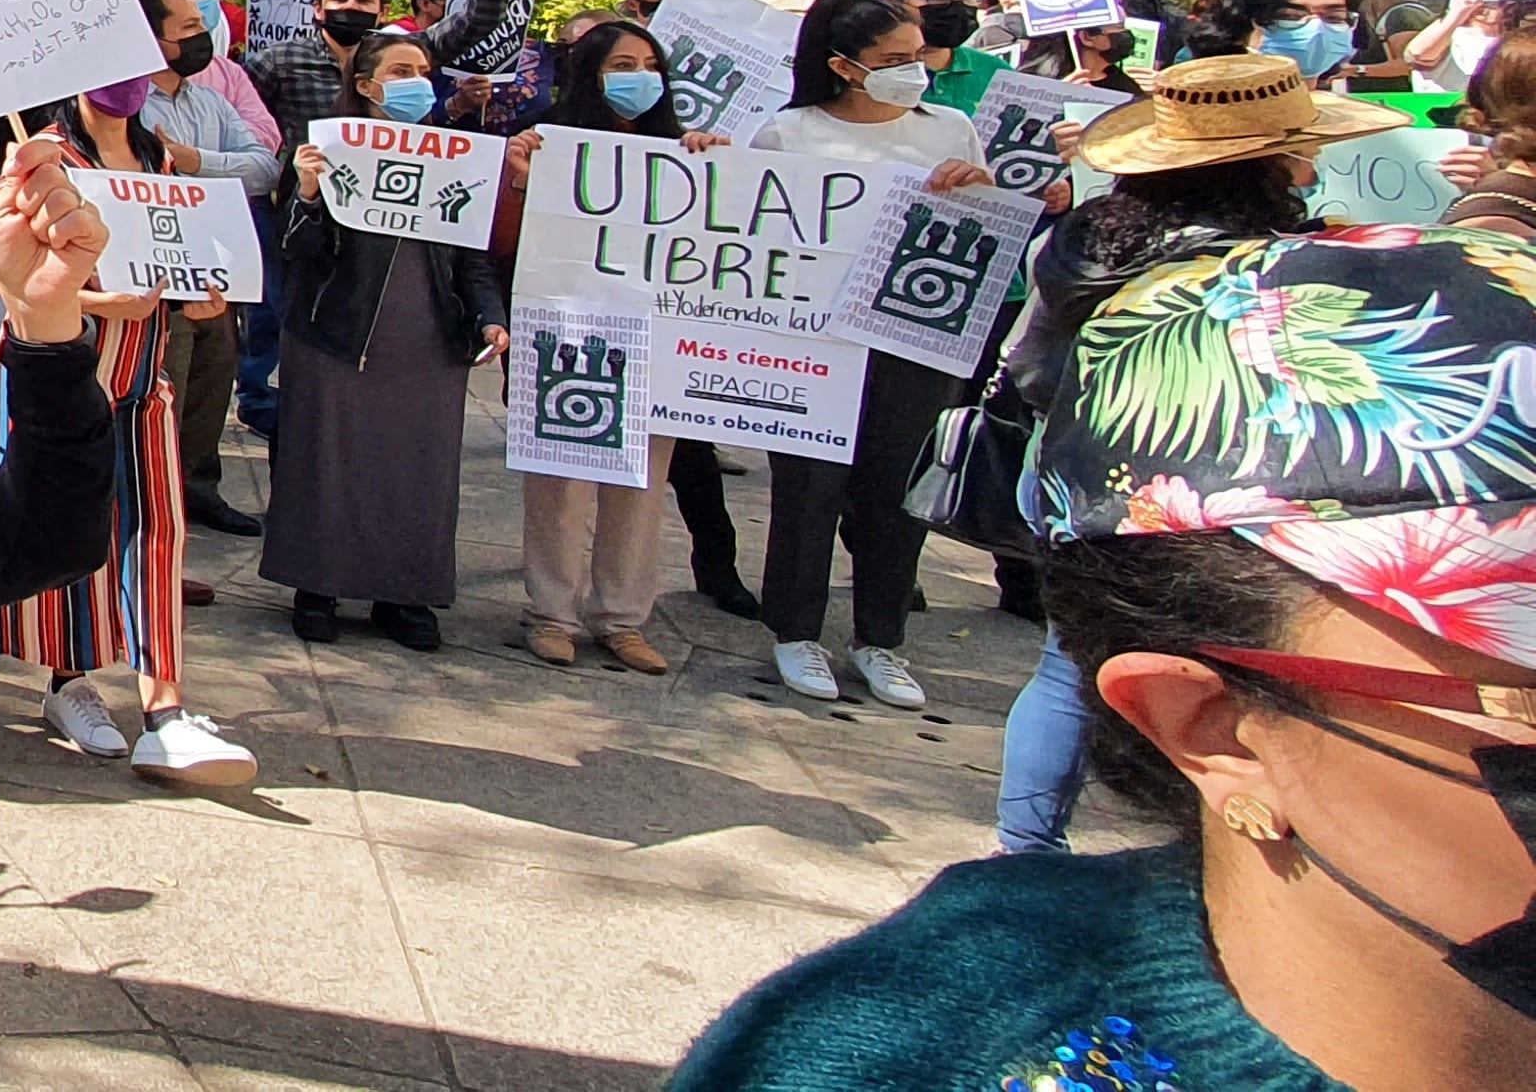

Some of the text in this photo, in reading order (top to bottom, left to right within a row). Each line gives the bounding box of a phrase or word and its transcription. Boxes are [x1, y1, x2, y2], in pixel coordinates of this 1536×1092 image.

[340, 121, 472, 161] UDLAP
[108, 177, 206, 209] UDLAP
[572, 140, 866, 246] UDLAP
[362, 207, 424, 234] CIDE
[152, 246, 193, 266] CIDE
[128, 261, 230, 293] LIBRES
[676, 338, 830, 377] Más ciencia
[687, 370, 809, 406] SIPACIDE
[650, 403, 848, 448] Menos obediencia
